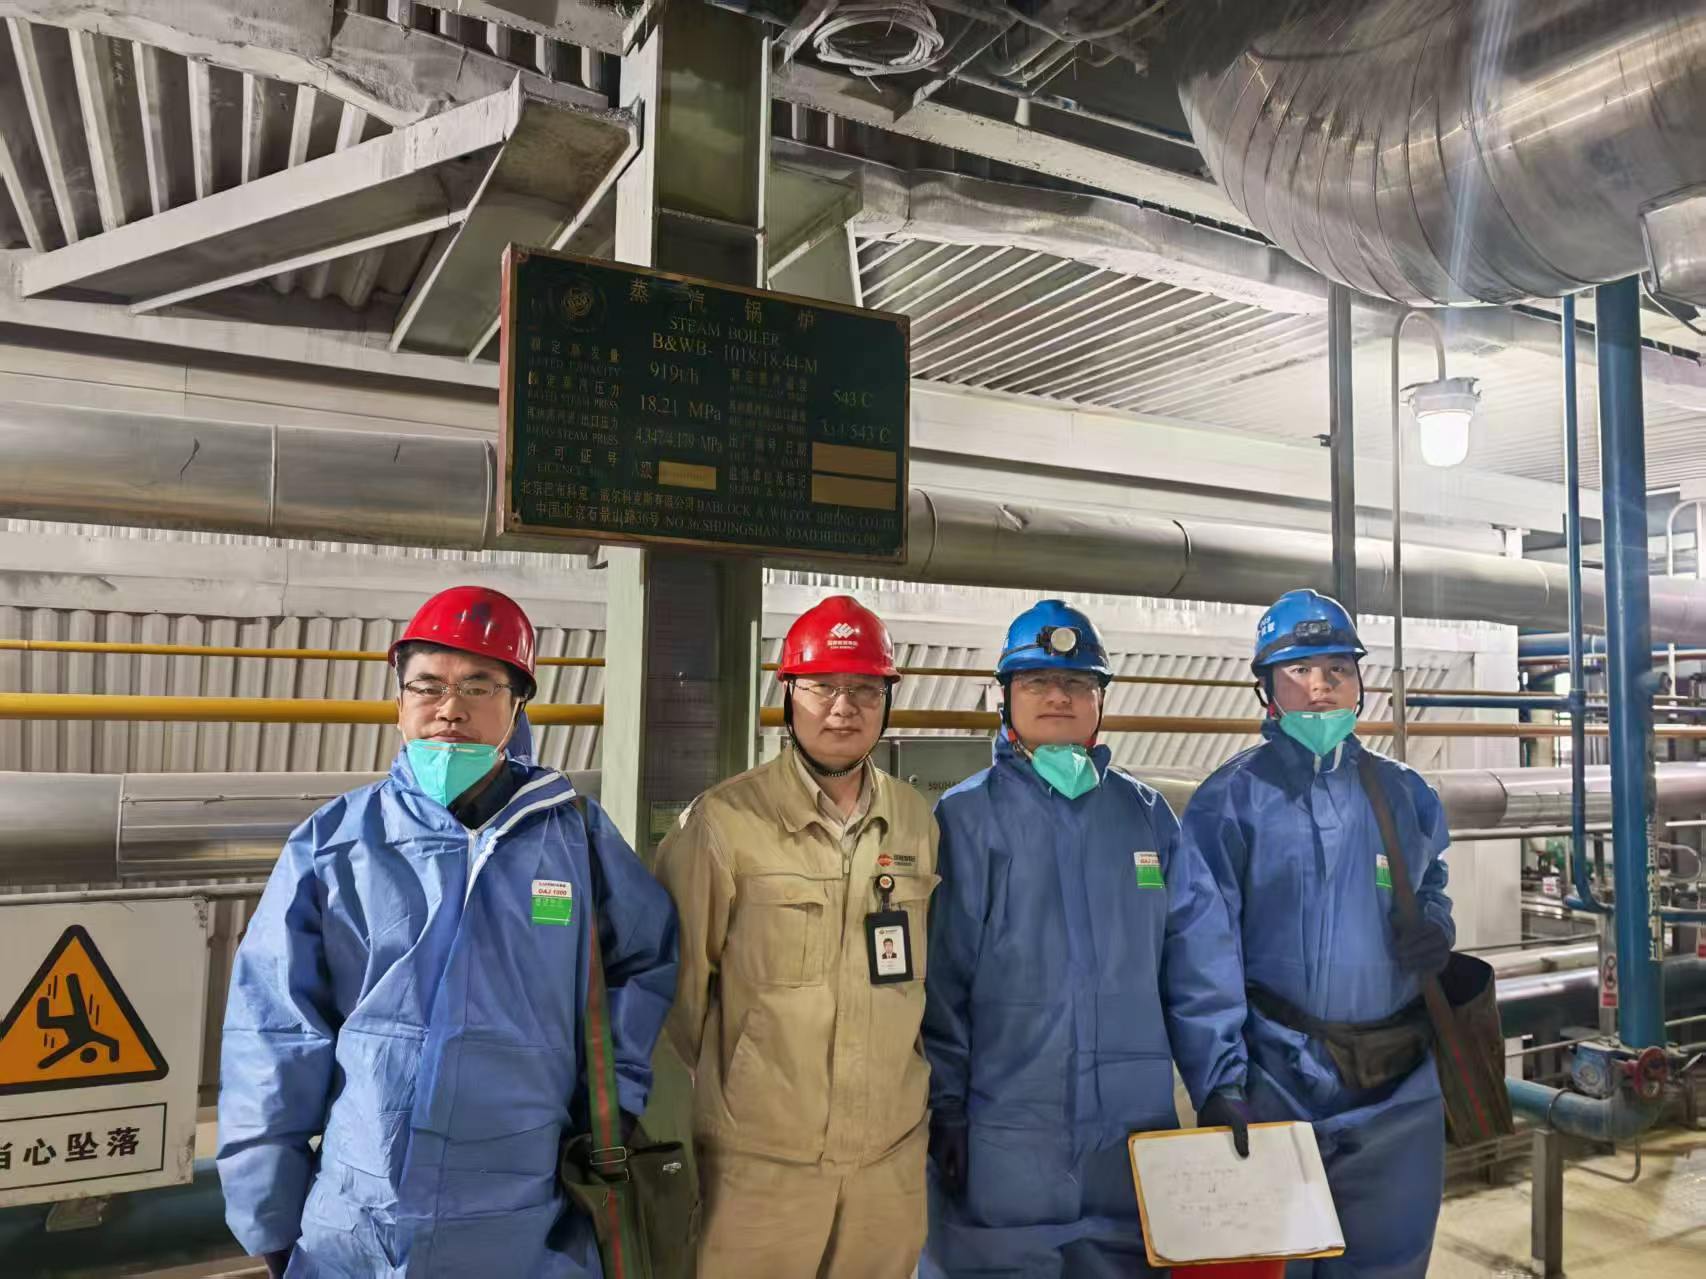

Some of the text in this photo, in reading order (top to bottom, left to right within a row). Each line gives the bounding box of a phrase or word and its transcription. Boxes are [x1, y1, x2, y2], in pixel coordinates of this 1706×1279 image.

[669, 315, 779, 346] STEAM BOILER
[640, 394, 677, 417] 18.21
[689, 400, 721, 421] MPa
